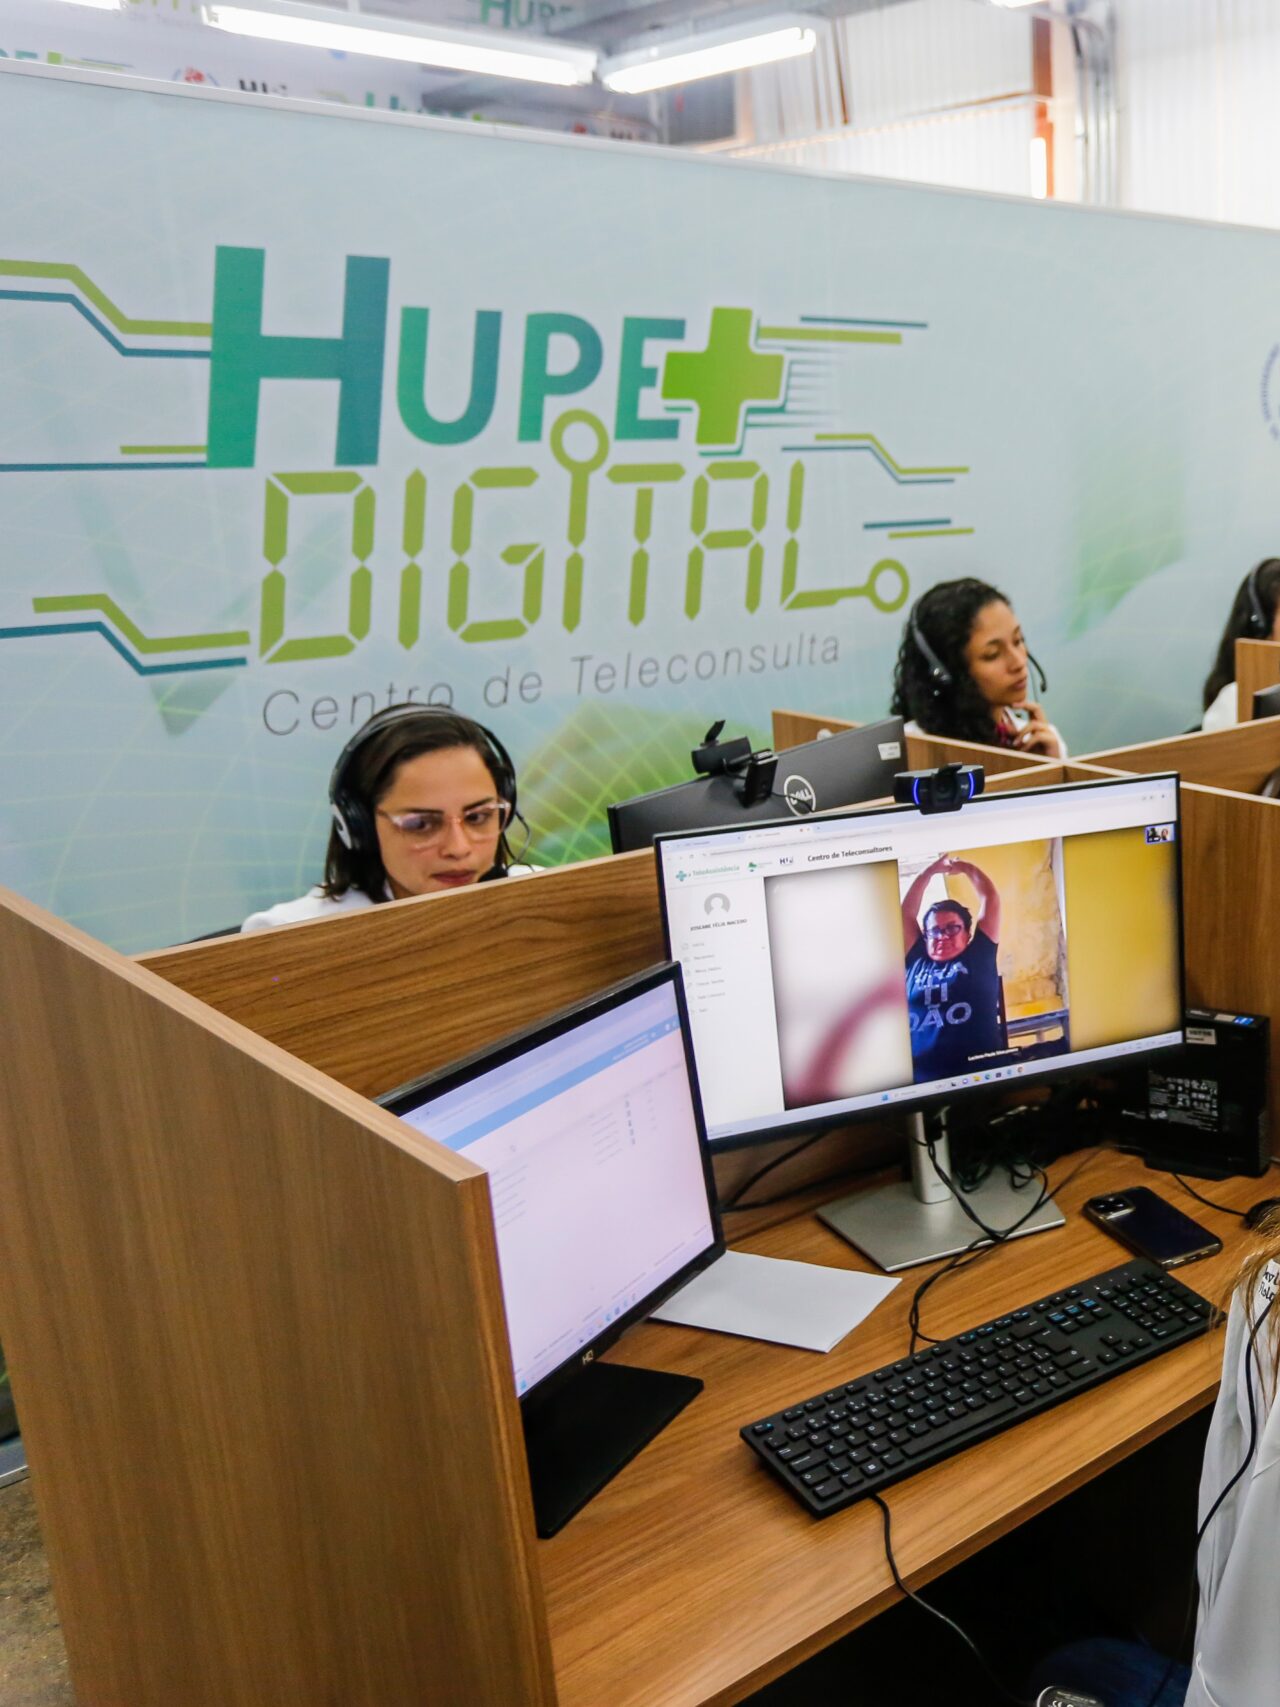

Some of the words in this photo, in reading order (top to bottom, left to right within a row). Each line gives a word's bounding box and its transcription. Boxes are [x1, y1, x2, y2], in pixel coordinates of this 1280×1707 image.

[259, 409, 909, 664] DIGITAL
[263, 682, 455, 736] Centro
[483, 666, 543, 708] de
[570, 633, 840, 695] Teleconsulta
[807, 852, 830, 862] Centro
[841, 844, 893, 859] Teleconsultores
